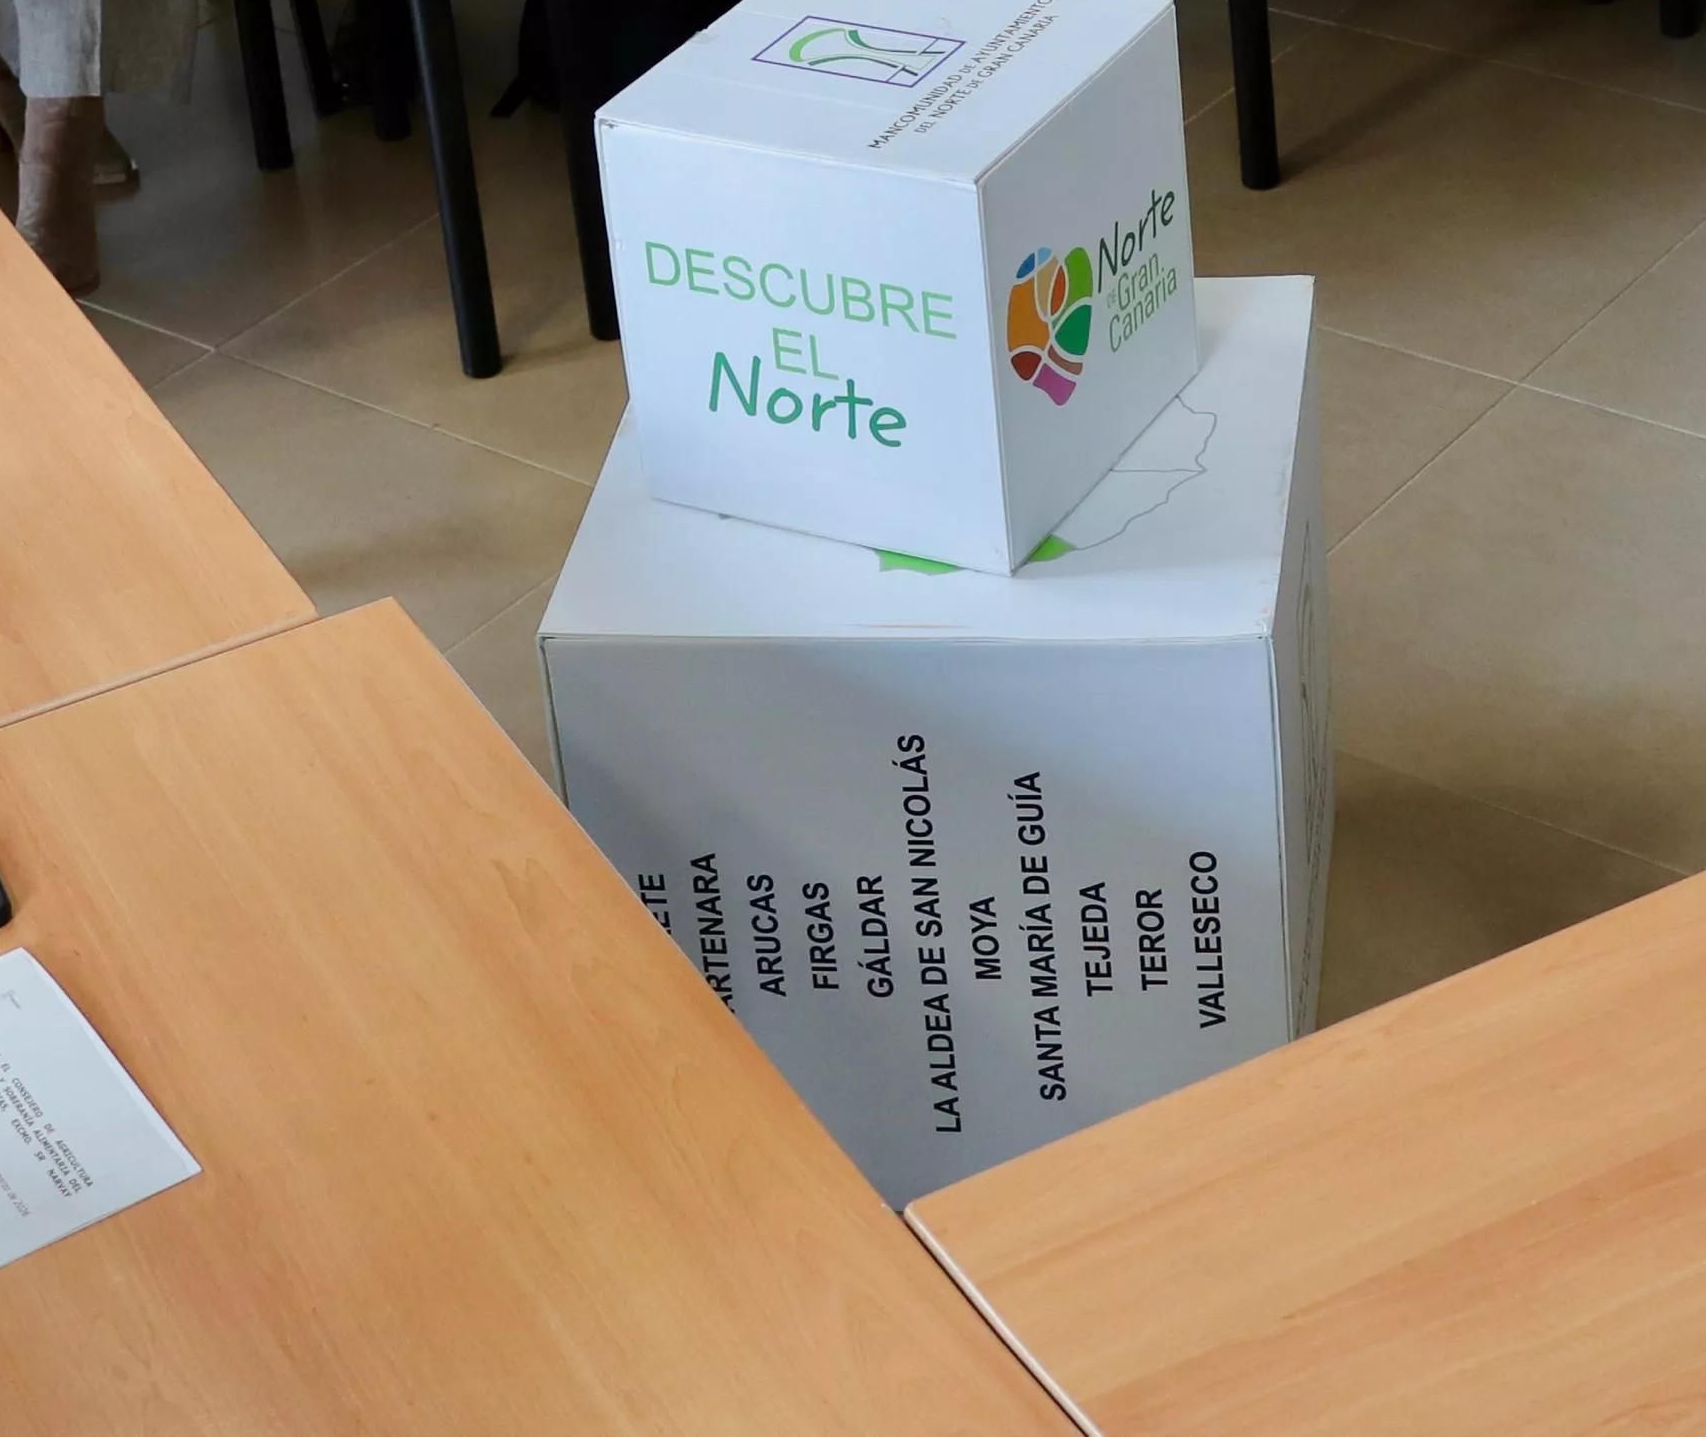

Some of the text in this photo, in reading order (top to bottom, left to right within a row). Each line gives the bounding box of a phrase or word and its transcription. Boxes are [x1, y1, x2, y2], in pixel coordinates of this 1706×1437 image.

[868, 74, 963, 149] MANCOMUNIDAD
[959, 63, 976, 75] DE
[914, 14, 1060, 134] DEL NORTE DE GRAN CANARIA
[645, 241, 956, 339] DESCUBRE
[1097, 189, 1175, 294] Norte
[1117, 253, 1159, 312] Gran
[771, 327, 839, 381] EL
[1108, 266, 1178, 353] Canaria
[708, 351, 907, 448] Norte
[746, 874, 787, 997] ARUCAS
[801, 882, 840, 990] FIRGAS
[856, 875, 894, 998] GÁLDAR
[891, 734, 962, 1133] LA ALDEA DE SAN NICOLÁS
[968, 896, 1002, 980] MOYA
[1007, 771, 1067, 1101] SANTA MARÍA DE GUÍA
[1079, 882, 1113, 997] TEJEDA
[1135, 888, 1169, 992] TEROR
[1188, 851, 1227, 1029] VALLESECO
